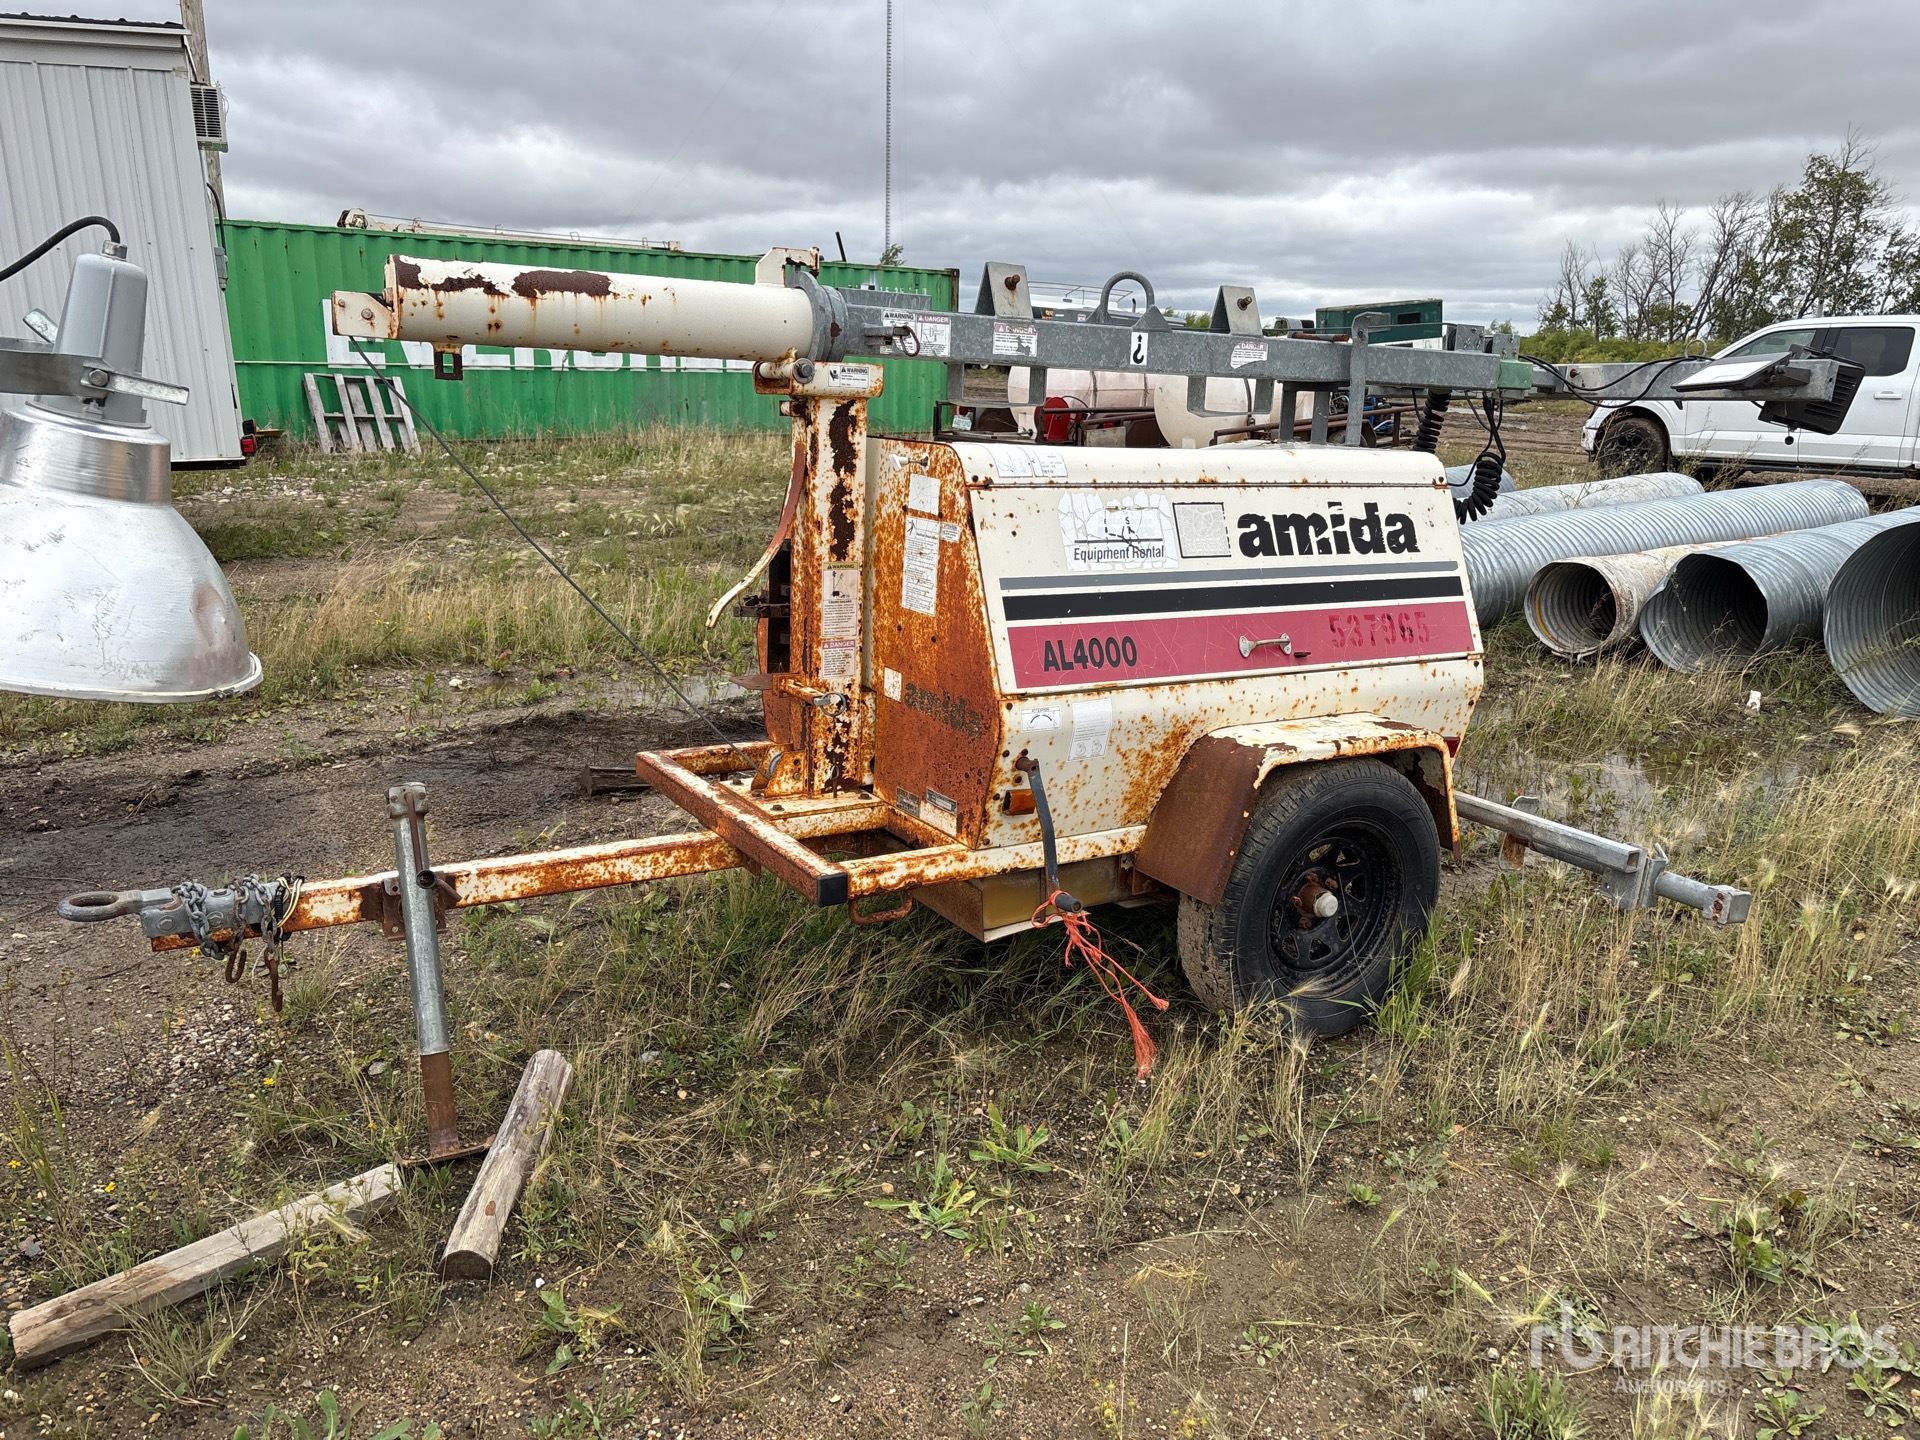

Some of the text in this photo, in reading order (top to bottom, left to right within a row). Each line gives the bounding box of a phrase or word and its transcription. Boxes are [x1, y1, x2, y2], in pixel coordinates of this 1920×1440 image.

[889, 312, 914, 320] WARNING
[1237, 501, 1421, 558] amida
[1074, 545, 1164, 563] Equipment Rental
[1328, 611, 1430, 648] 537965
[829, 640, 855, 648] DANGER
[1044, 635, 1137, 672] AL4000
